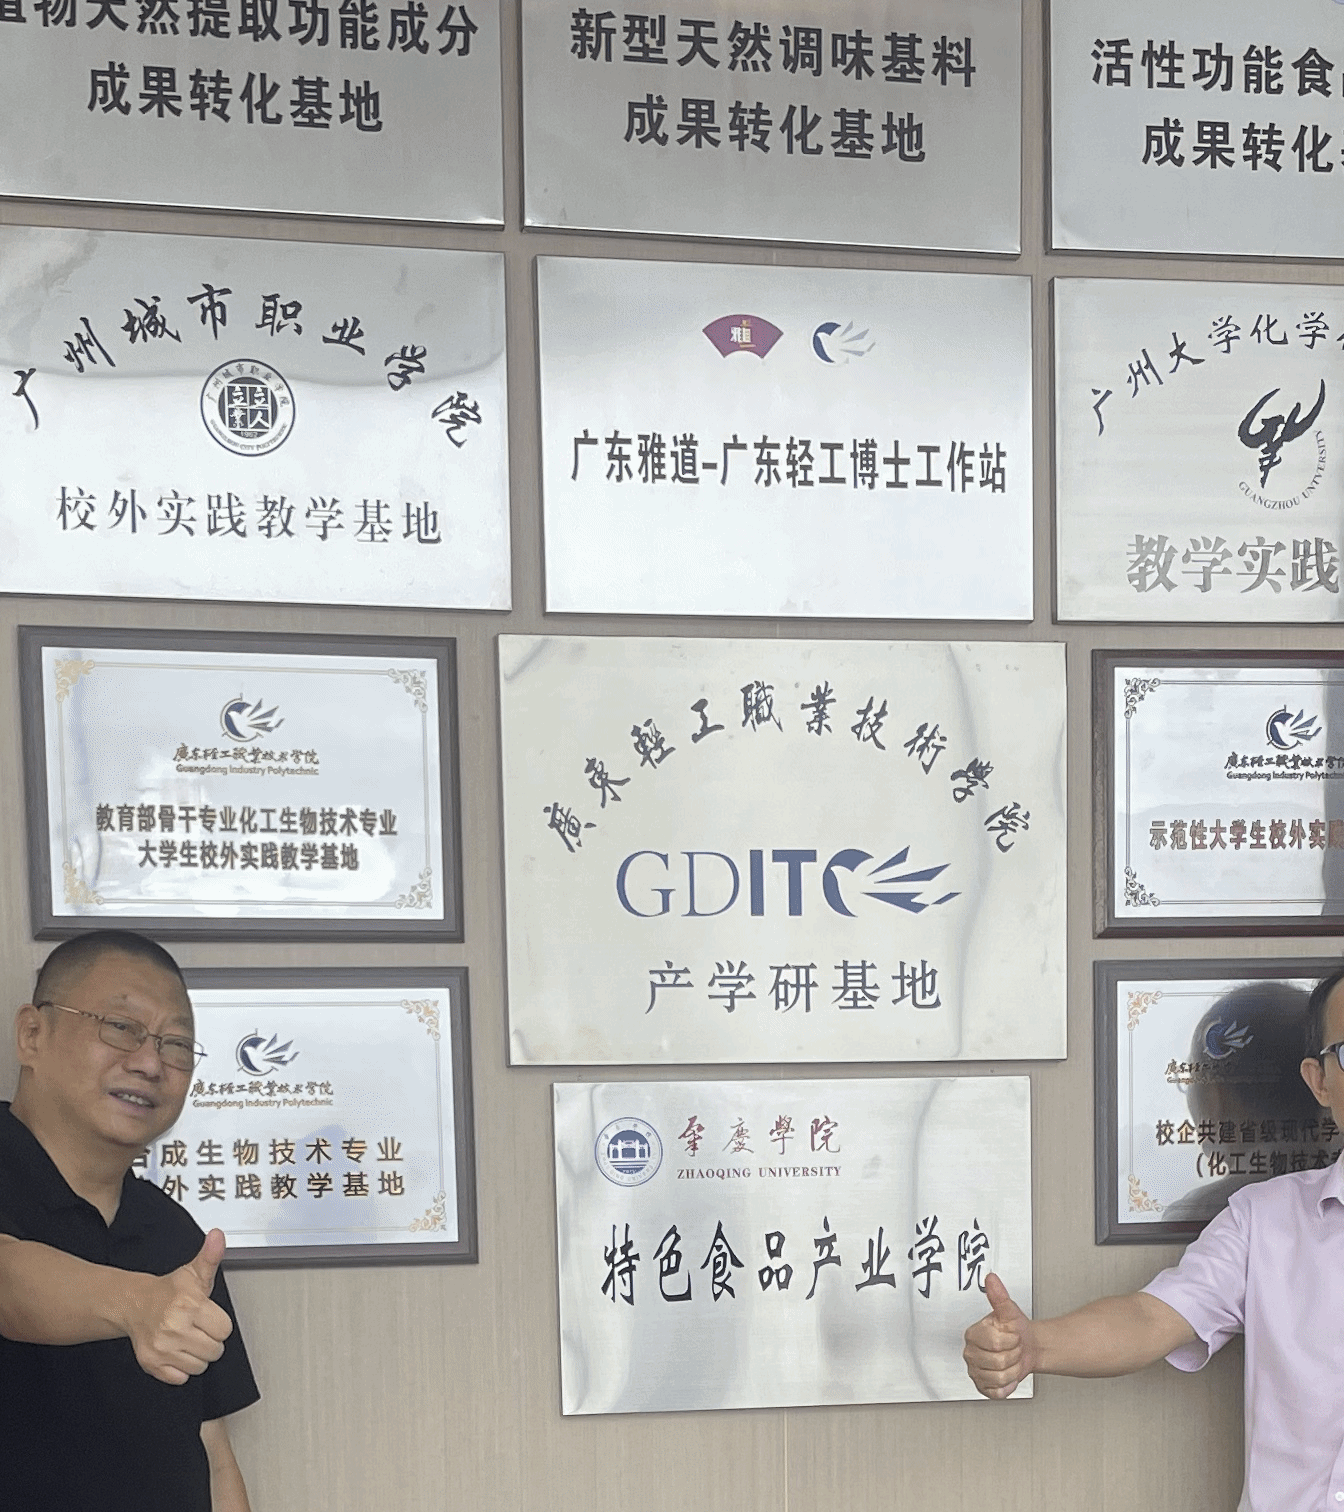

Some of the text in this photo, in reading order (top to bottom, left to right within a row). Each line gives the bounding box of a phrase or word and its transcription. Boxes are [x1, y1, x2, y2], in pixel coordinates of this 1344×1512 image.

[569, 7, 976, 88] 新型天然调味基料
[87, 61, 383, 132] 成果转化基地
[624, 93, 926, 163] 成果转化基地
[12, 283, 483, 448] 广州城市职业学院
[1239, 430, 1327, 510] GUANGZHOU UNIVERSITY
[55, 486, 442, 545] 校外实践教学基地
[176, 764, 319, 777] Guangdong Industry Polytechnic
[1226, 771, 1271, 781] Guangdong
[1272, 771, 1304, 781] Industry
[96, 804, 398, 837] 教育部骨干专业化工生物技术专业
[138, 840, 360, 872] 大学生校外实践教学基地
[645, 960, 942, 1014] 产学研基地
[192, 1098, 334, 1110] Guangdong Industry Polytechnic
[133, 1136, 404, 1168] 成生物技术专业
[677, 1166, 842, 1180] ZHAOQING UNIVERSITY
[137, 1171, 405, 1201] 外实践教学基地
[601, 1215, 990, 1306] 特色食品产业学院
